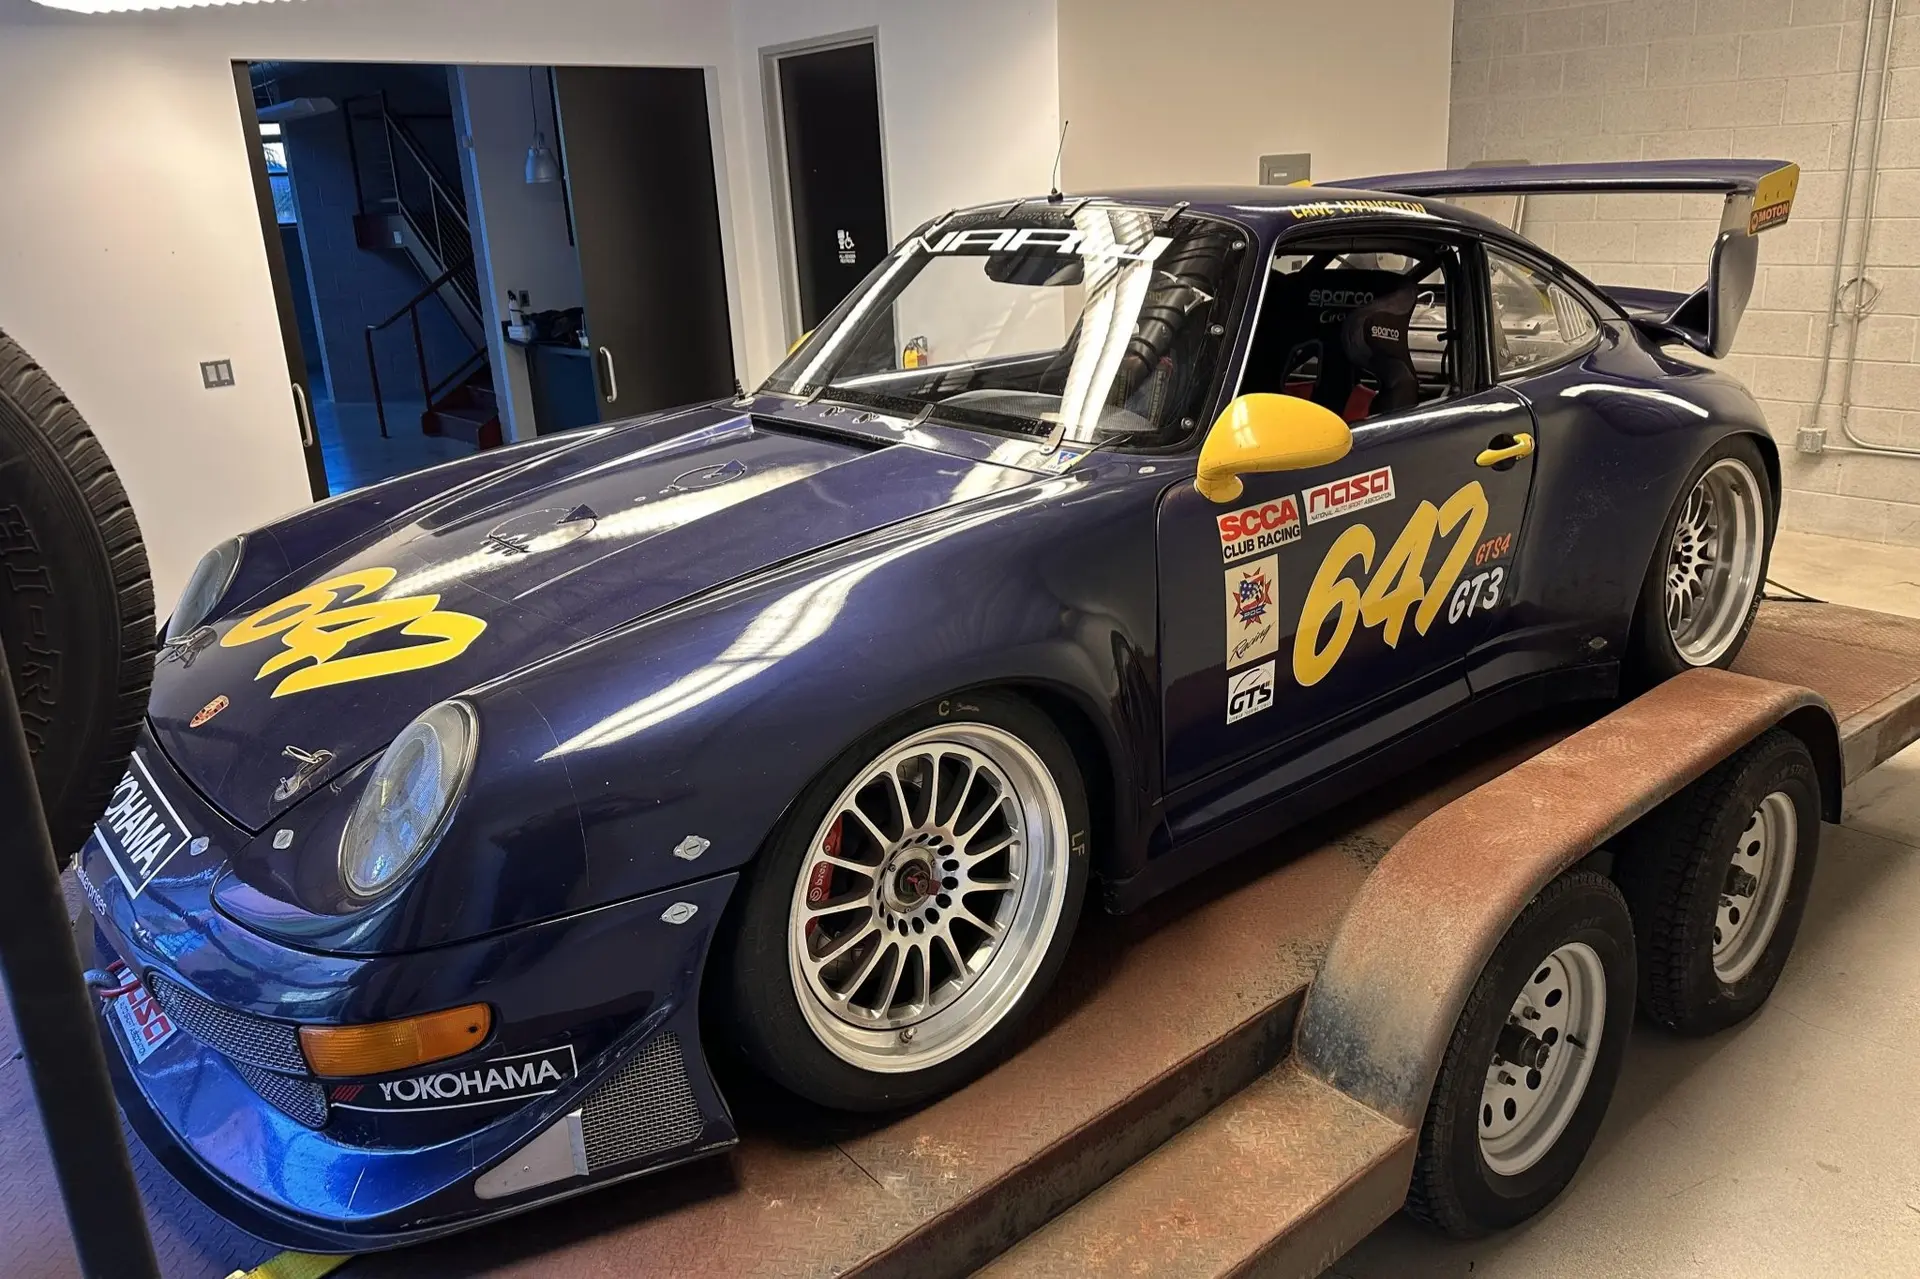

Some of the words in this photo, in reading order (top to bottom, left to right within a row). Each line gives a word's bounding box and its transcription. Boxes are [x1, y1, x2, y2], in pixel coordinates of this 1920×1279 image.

[1289, 202, 1335, 219] LANE
[1759, 202, 1789, 222] MOTON
[1309, 289, 1374, 307] sparco
[1371, 325, 1399, 339] sparco
[1220, 499, 1298, 542] SCCA
[1223, 538, 1255, 560] CLUB
[1257, 524, 1301, 550] RACING
[1475, 533, 1512, 567] GTS4
[1292, 480, 1490, 688] 647
[1449, 566, 1504, 625] GT3
[219, 567, 488, 698] 647
[1229, 621, 1276, 662] Racing
[1229, 683, 1272, 716] GTS
[379, 1059, 562, 1102] YOKOHAMA
